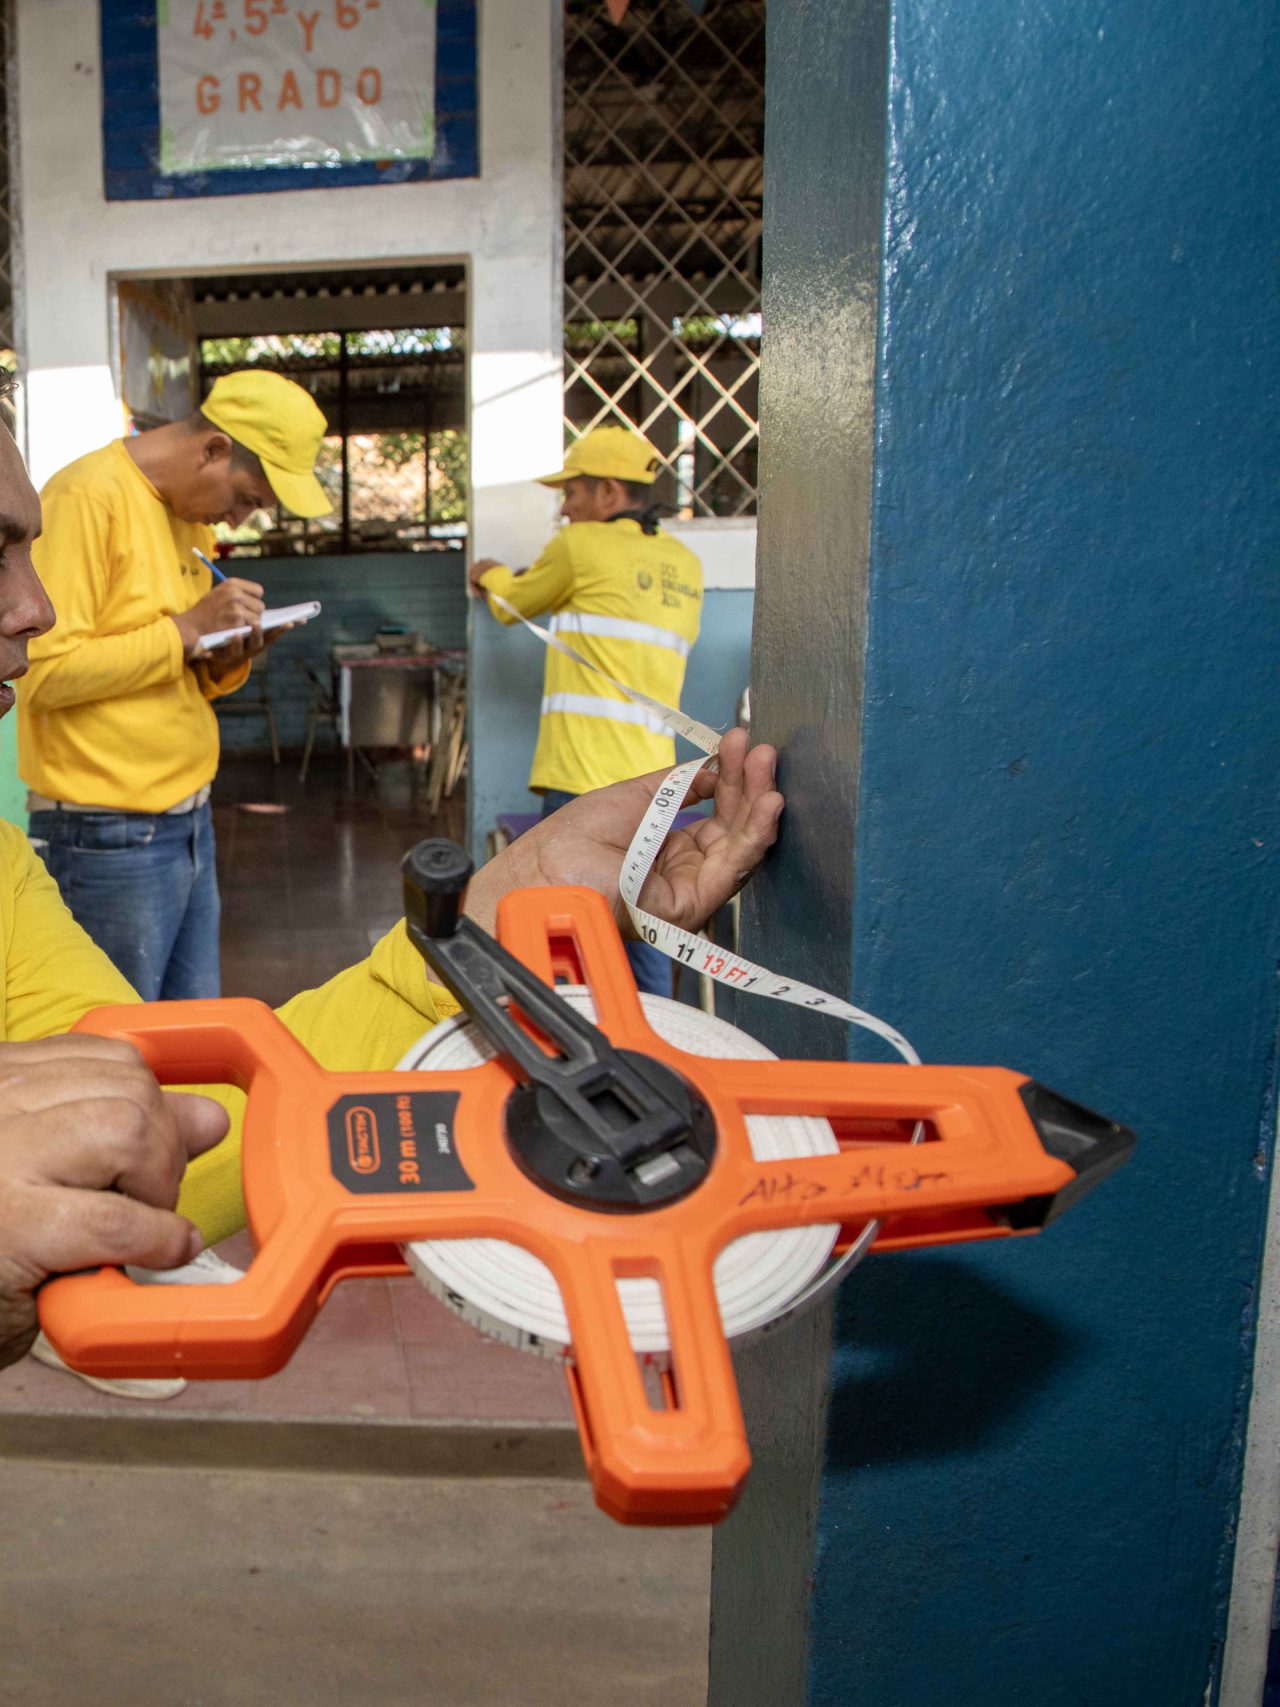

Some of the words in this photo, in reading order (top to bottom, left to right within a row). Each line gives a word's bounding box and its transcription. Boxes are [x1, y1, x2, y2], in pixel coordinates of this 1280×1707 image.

[295, 9, 322, 52] Y
[335, 0, 382, 30] 6
[195, 66, 383, 115] GRADO
[654, 787, 676, 808] 80
[641, 925, 658, 945] 10
[676, 943, 696, 962] 11
[701, 953, 726, 975] 13
[724, 966, 748, 983] FT
[743, 977, 758, 988] 1
[770, 986, 791, 996] 2
[399, 1140, 417, 1158] m
[397, 1160, 421, 1185] 30
